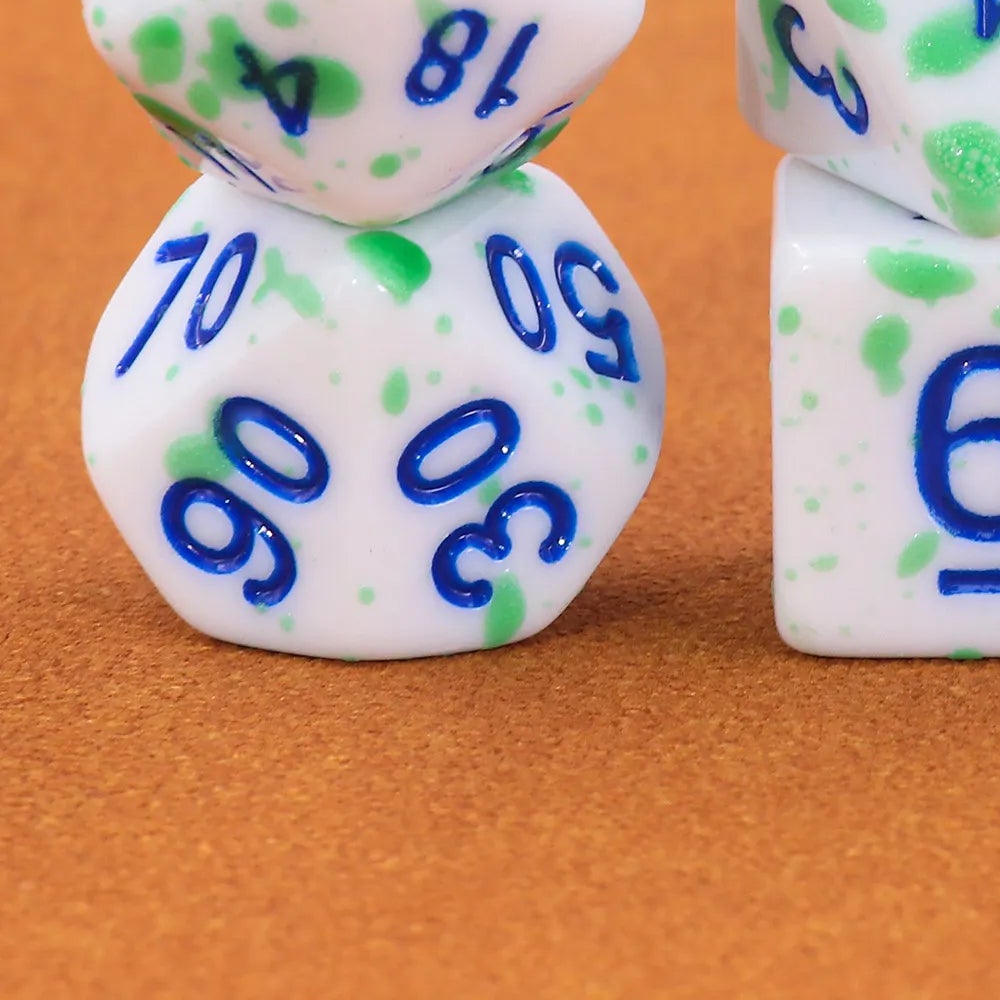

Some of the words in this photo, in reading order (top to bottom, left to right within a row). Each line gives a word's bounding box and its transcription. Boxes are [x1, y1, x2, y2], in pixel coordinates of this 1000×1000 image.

[232, 42, 319, 137] 4
[404, 8, 540, 120] 18
[772, 3, 870, 136] 3
[113, 231, 259, 379] 70
[485, 232, 642, 384] 50
[158, 396, 331, 609] 90
[395, 397, 579, 611] 30
